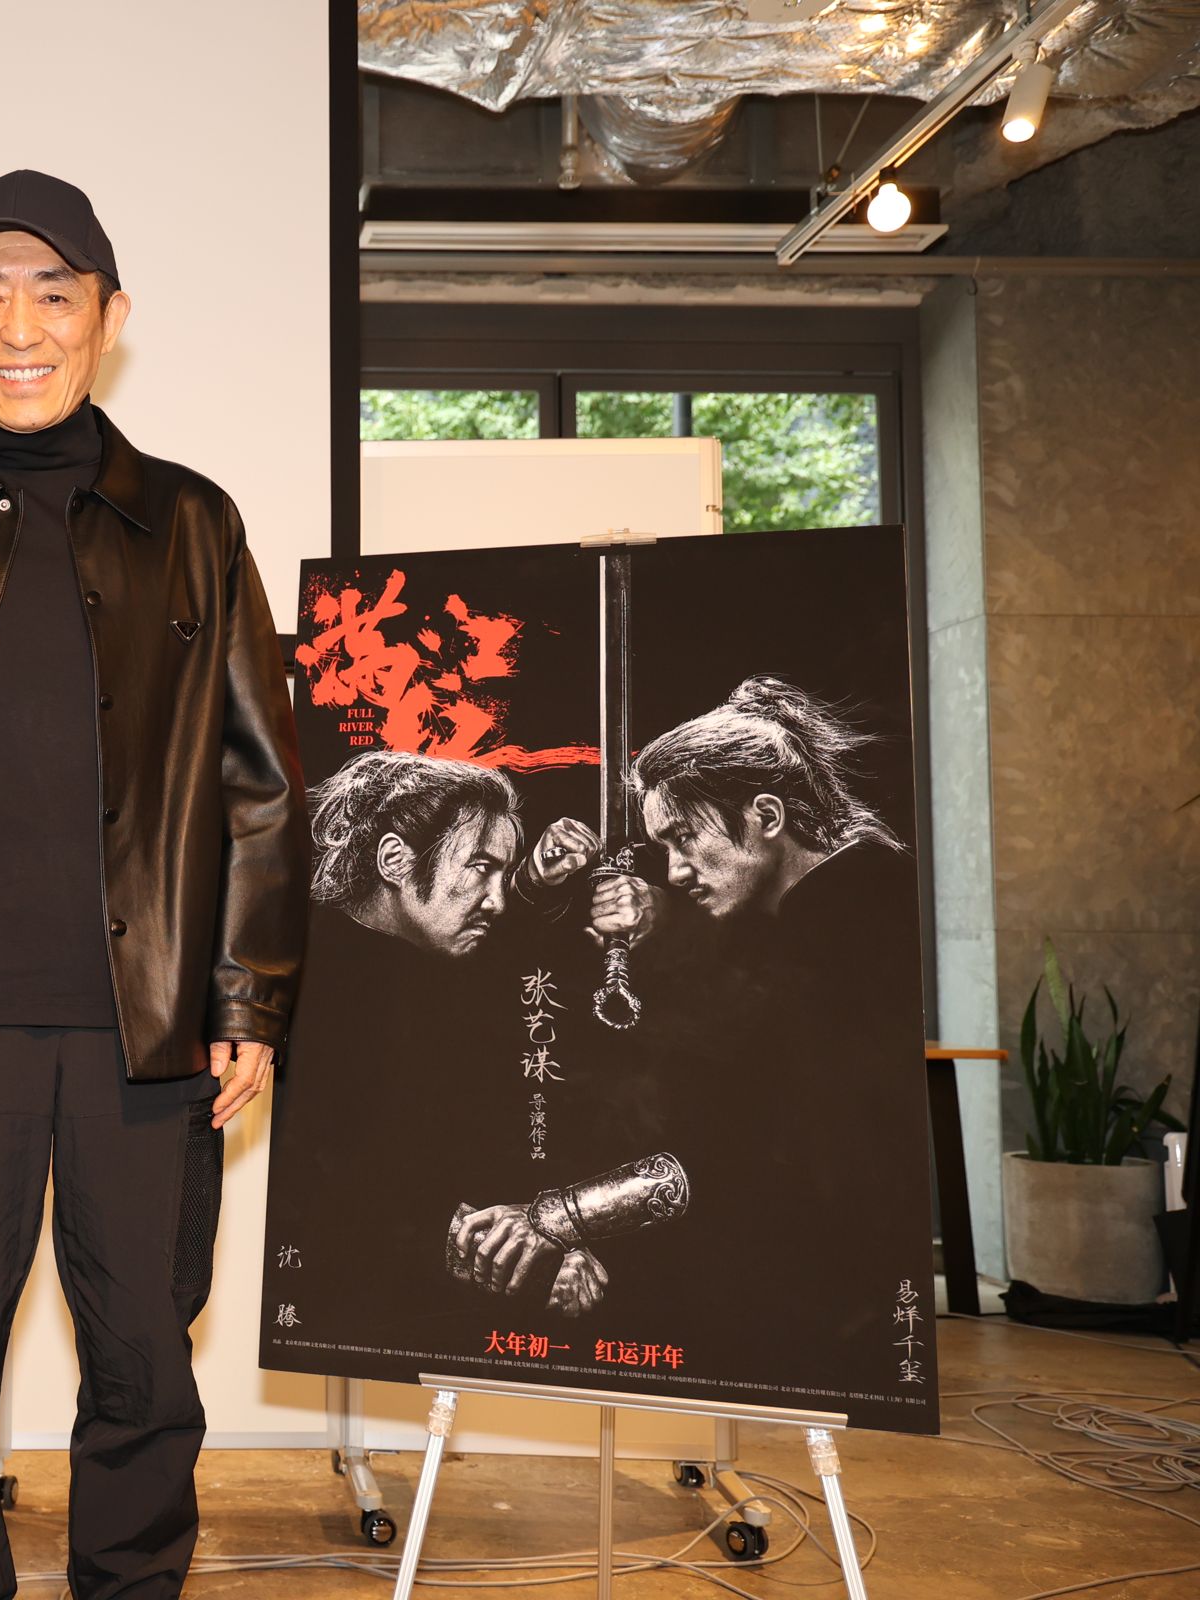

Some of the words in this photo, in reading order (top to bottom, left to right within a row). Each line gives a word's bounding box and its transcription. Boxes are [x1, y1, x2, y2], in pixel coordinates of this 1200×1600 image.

[339, 722, 374, 732] RIVER
[347, 708, 375, 719] FULL
[350, 735, 374, 746] RED
[520, 967, 568, 1084] 张艺谋
[528, 1093, 547, 1160] 导演作品
[484, 1330, 571, 1359] 大年初一
[595, 1339, 684, 1369] 红运开年
[892, 1279, 926, 1384] 易烊千玺
